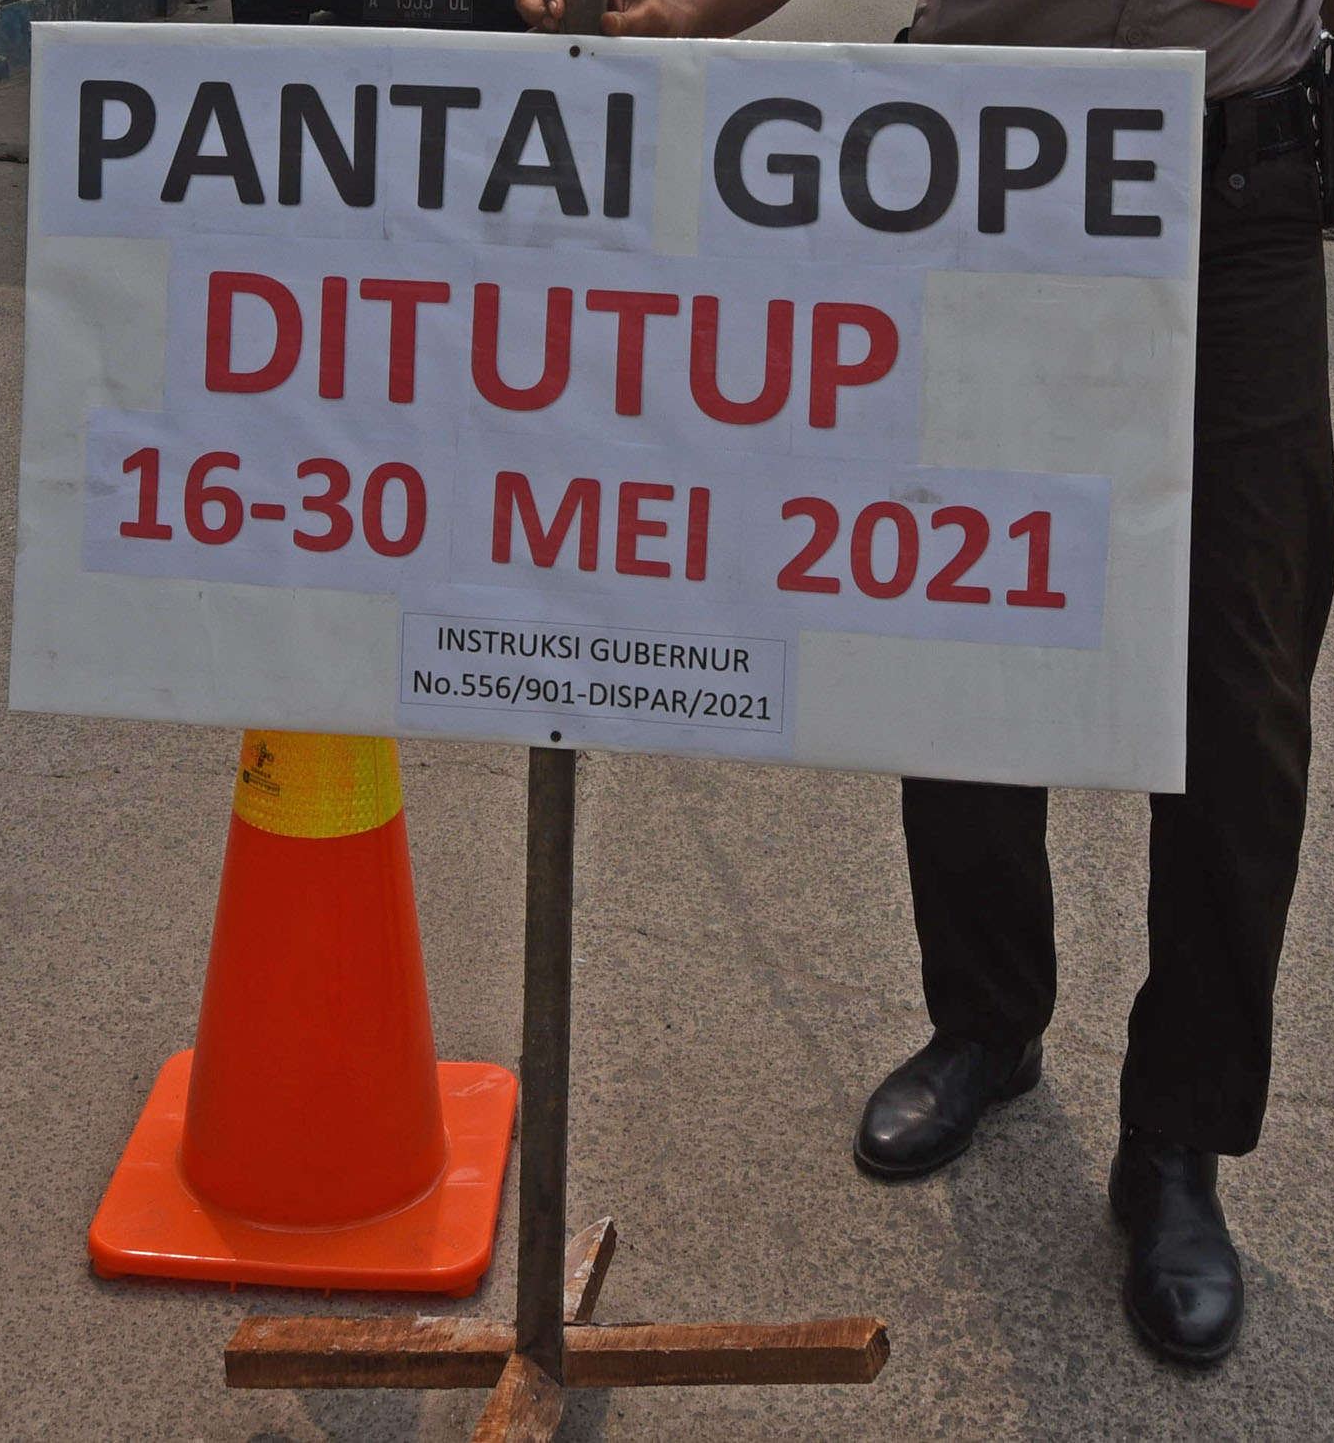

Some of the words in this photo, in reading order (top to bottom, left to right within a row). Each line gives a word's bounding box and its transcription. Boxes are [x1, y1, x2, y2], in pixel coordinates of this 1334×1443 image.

[75, 78, 635, 219] PANTAI
[713, 95, 1165, 238] GOPE
[202, 269, 900, 430] DITUTUP
[118, 445, 427, 558] 16-30
[490, 470, 710, 582] MEI
[776, 494, 1068, 610] 2021
[413, 669, 773, 722] No.556/901-DISPAR/2021
[436, 625, 581, 663] INSTRUKSI
[588, 635, 751, 674] GUBERNUR
